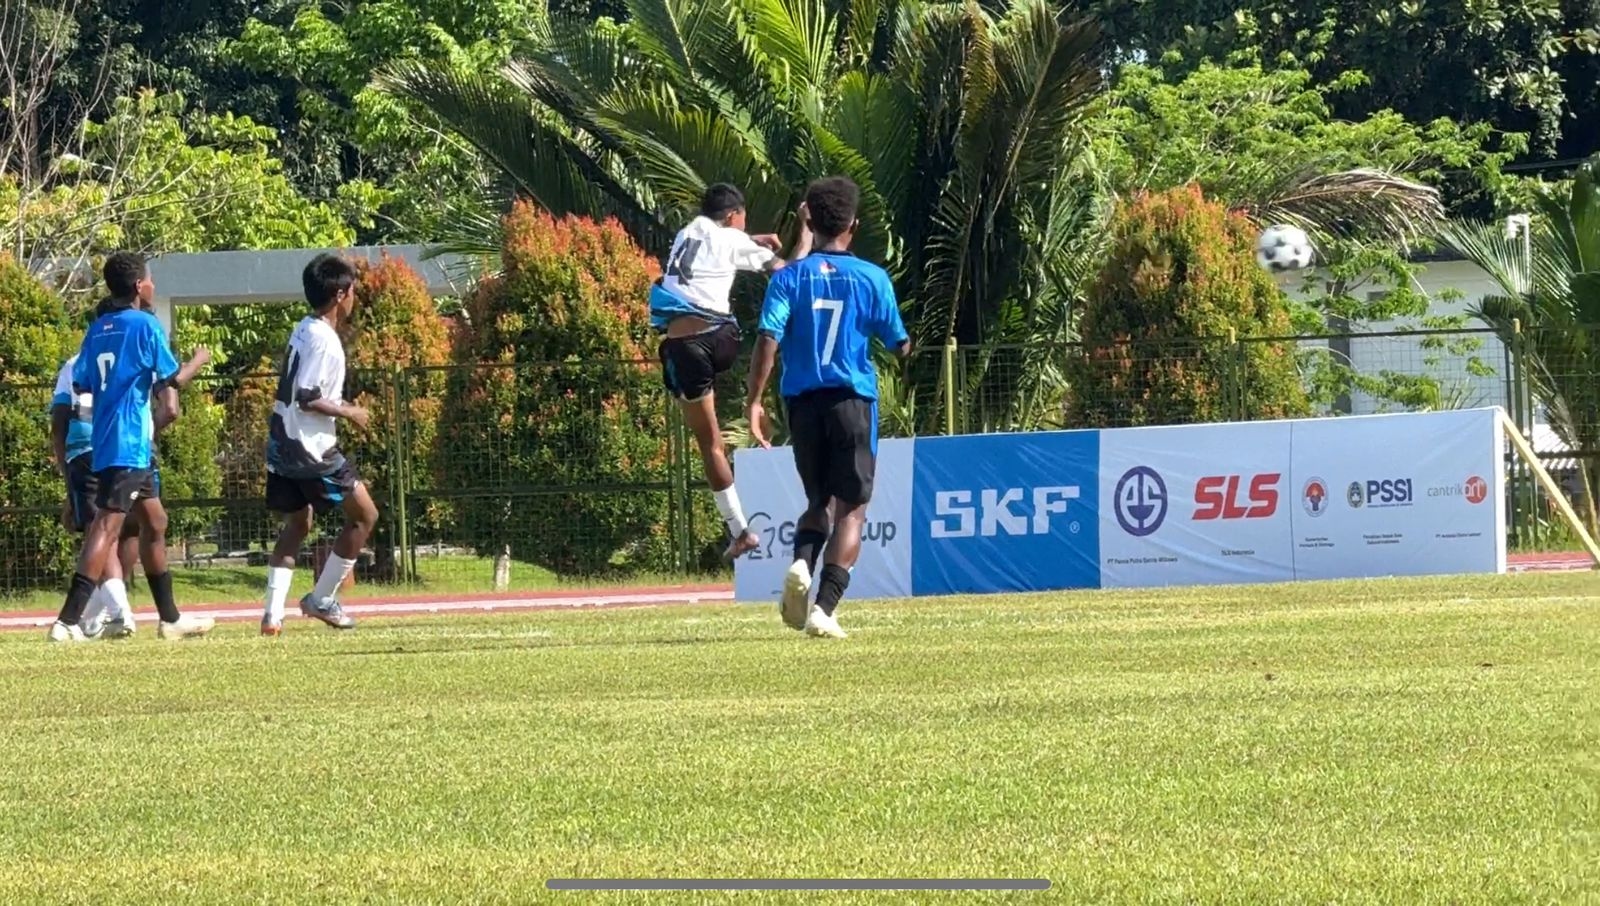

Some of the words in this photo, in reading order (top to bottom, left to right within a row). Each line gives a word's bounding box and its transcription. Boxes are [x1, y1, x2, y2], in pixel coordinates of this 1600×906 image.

[811, 299, 843, 366] 7
[930, 485, 1080, 538] SKF
[1191, 473, 1281, 521] SLS
[1366, 478, 1413, 504] PSSI
[861, 518, 897, 547] up
